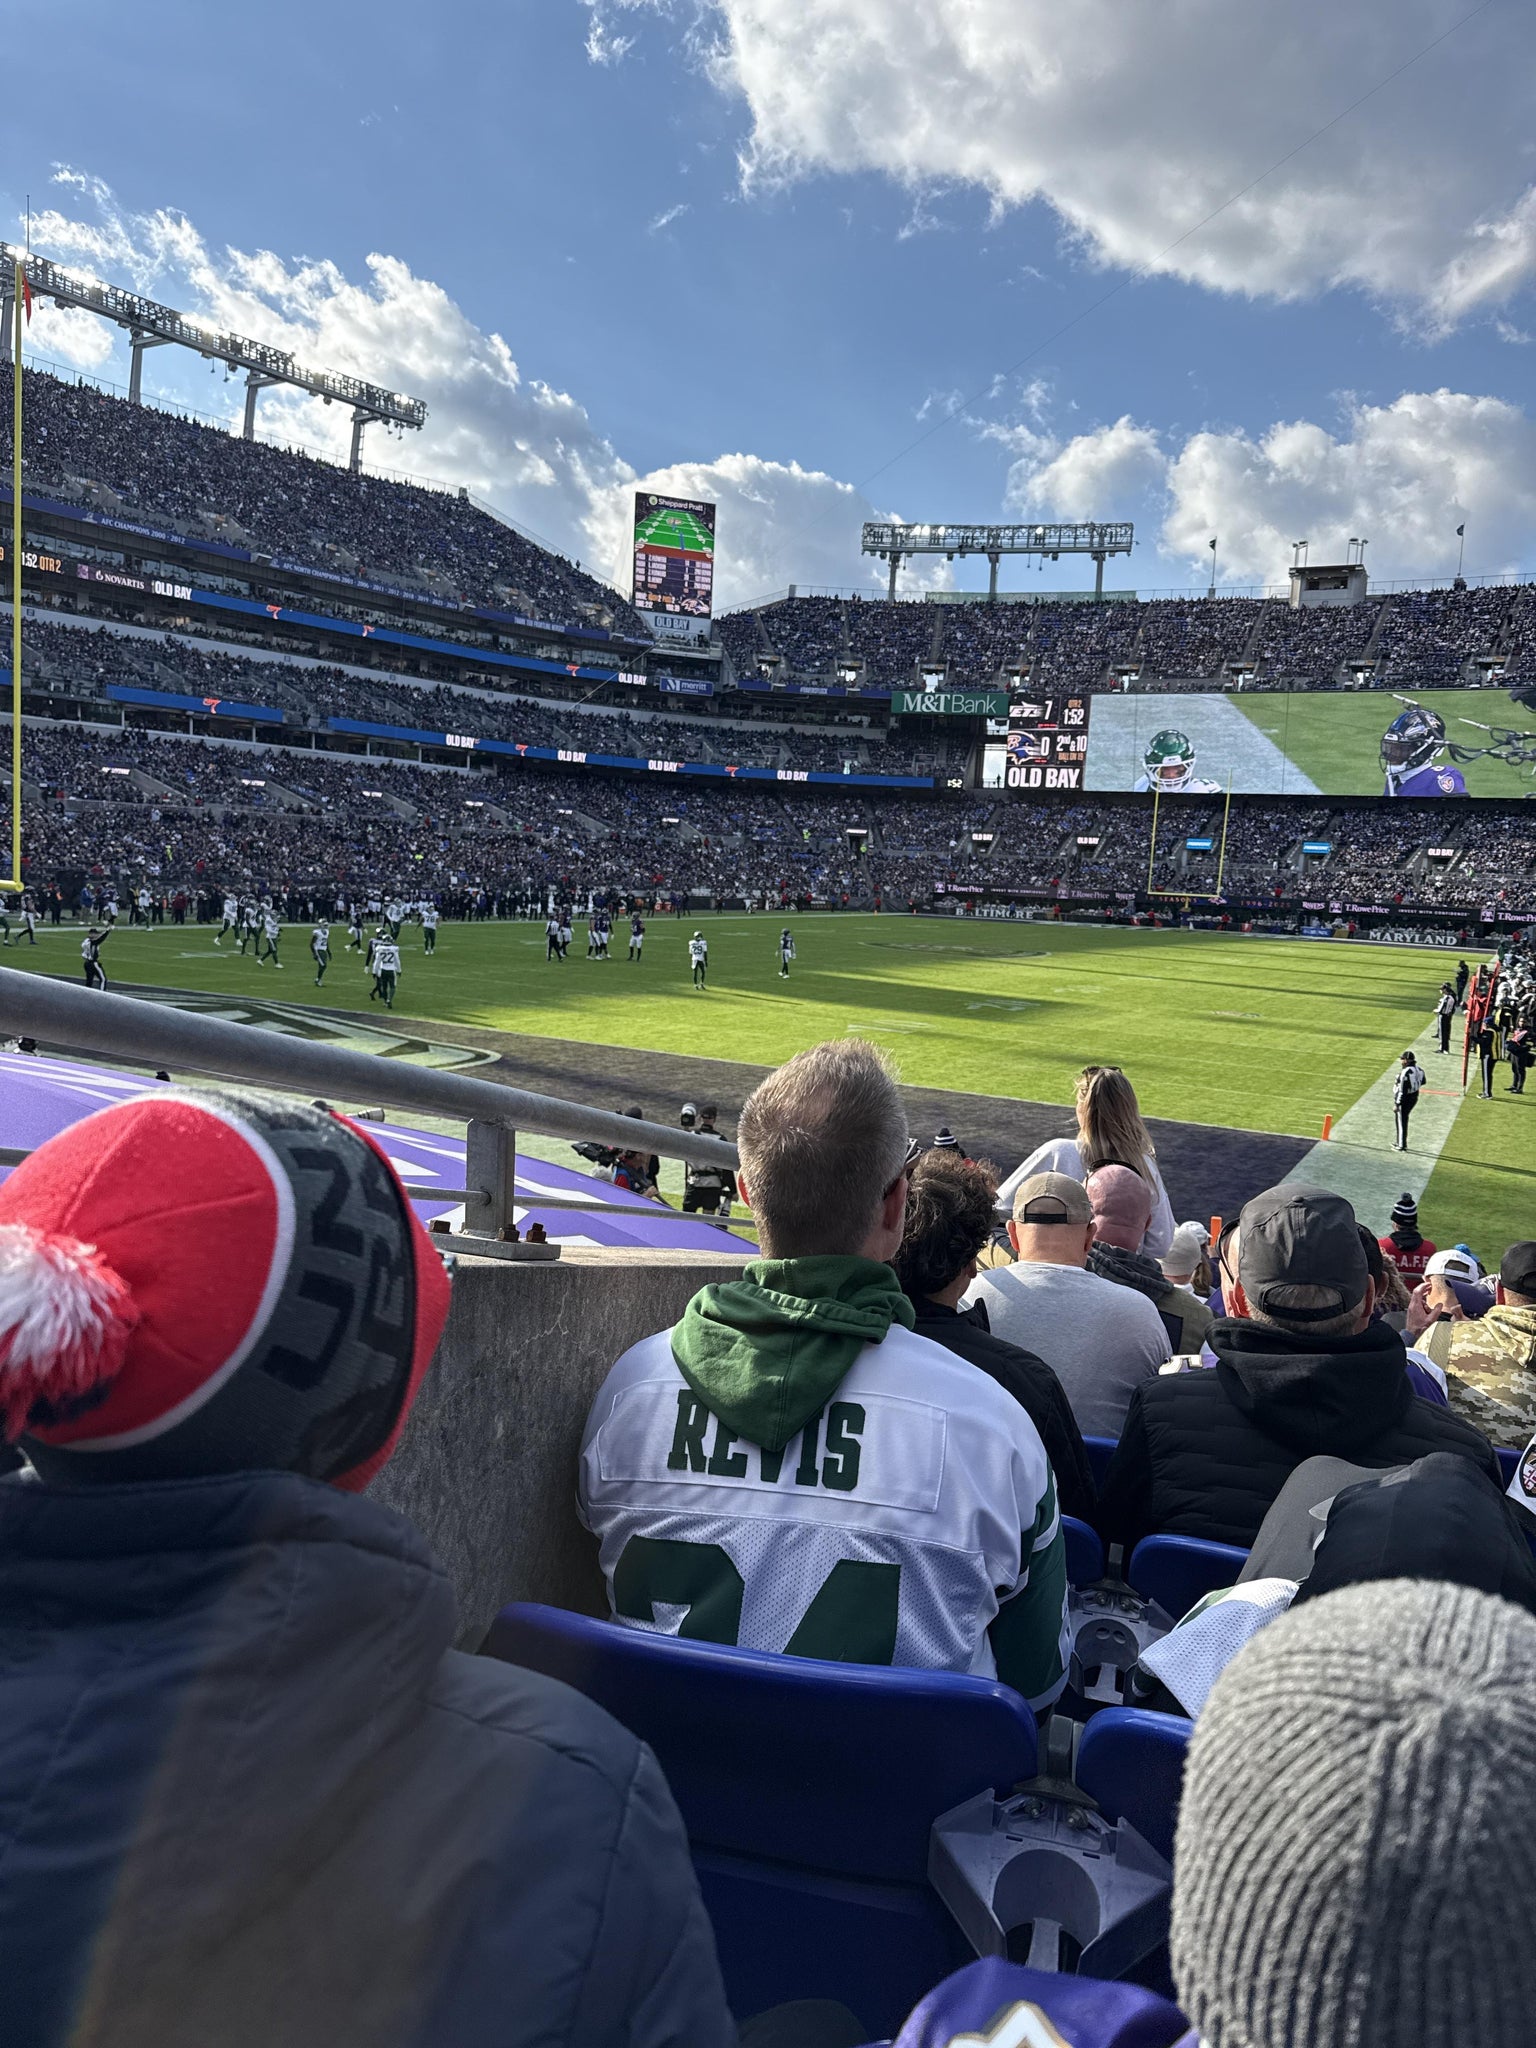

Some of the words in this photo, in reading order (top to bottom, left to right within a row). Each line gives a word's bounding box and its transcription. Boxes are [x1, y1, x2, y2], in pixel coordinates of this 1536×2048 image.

[101, 518, 113, 527] AFC
[114, 520, 150, 536] CHAMPIONS
[22, 551, 38, 568] 1:52
[39, 555, 55, 572] QTR
[55, 558, 62, 574] 2
[104, 574, 145, 590] NOVARTIS
[154, 580, 173, 596] OLD
[174, 584, 192, 600] BAY
[656, 616, 672, 628] OLD
[673, 618, 689, 630] BAY
[618, 672, 633, 684] OLD
[633, 674, 647, 686] BAY
[902, 693, 951, 713] M&T
[951, 694, 997, 714] Bank
[1044, 700, 1053, 720] 7
[1063, 708, 1084, 725] 1:52
[446, 734, 460, 747] OLD
[461, 736, 475, 749] BAY
[1040, 736, 1050, 756] 0
[558, 750, 572, 762] OLD
[572, 751, 587, 764] BAY
[648, 760, 663, 771] OLD
[664, 761, 678, 772] BAY
[777, 770, 792, 780] OLD
[792, 770, 809, 782] BAY
[1008, 767, 1042, 788] OLD
[1046, 768, 1080, 789] BAY
[972, 833, 982, 841] OLD
[1077, 836, 1088, 844] OLD
[1088, 837, 1100, 845] BAY
[1428, 848, 1440, 856] OLD
[1441, 848, 1454, 856] BAY
[956, 907, 1034, 920] BLTIMRE
[1369, 932, 1458, 946] MARYLAND
[380, 952, 394, 964] 22
